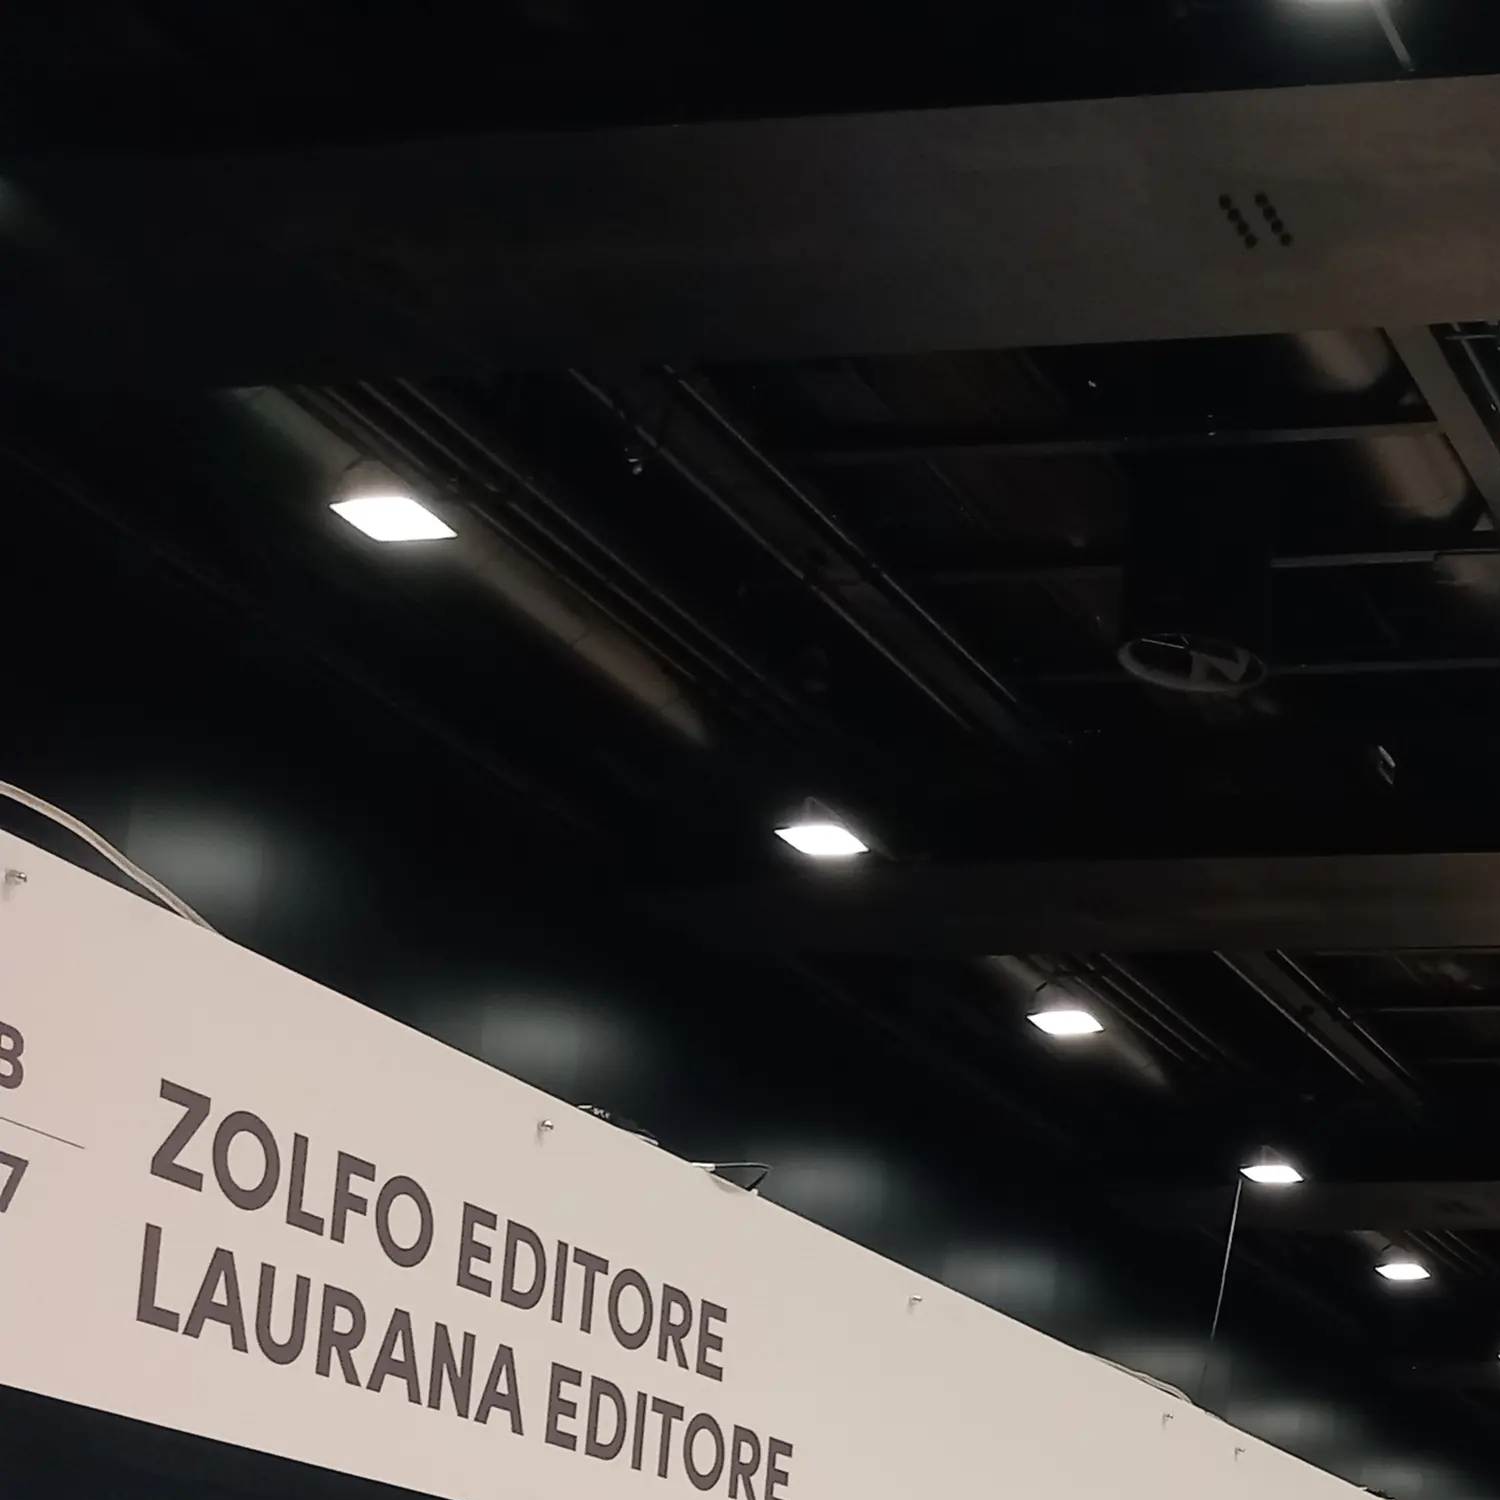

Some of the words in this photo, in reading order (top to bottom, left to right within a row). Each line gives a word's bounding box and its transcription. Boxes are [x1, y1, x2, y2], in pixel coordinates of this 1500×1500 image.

[136, 1223, 525, 1436] LAURANA
[150, 1078, 433, 1268] ZOLFO
[456, 1202, 727, 1382] EDITORE
